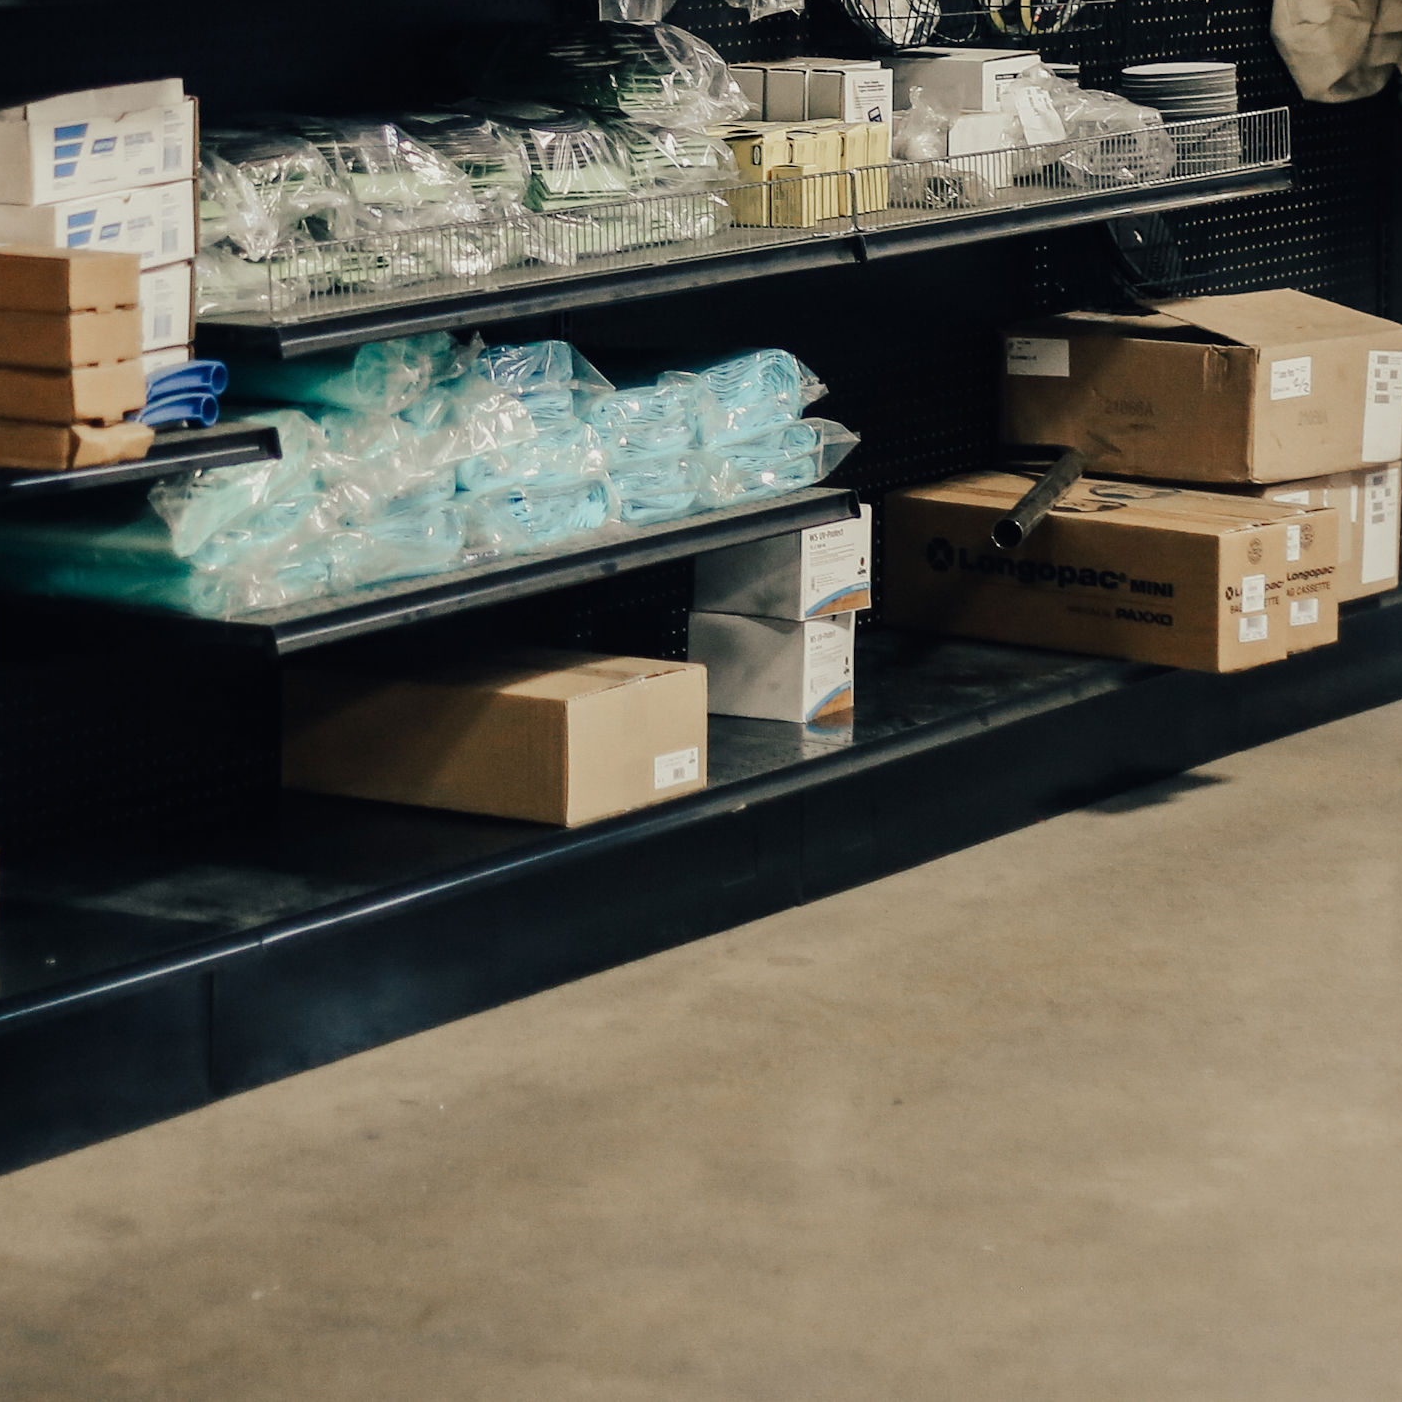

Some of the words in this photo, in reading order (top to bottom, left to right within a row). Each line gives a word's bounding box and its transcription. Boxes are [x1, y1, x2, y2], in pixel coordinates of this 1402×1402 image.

[809, 533, 818, 543] WS
[1131, 579, 1174, 599] MINI
[1296, 581, 1331, 596] CASSETTE
[1115, 607, 1174, 627] PAXXO
